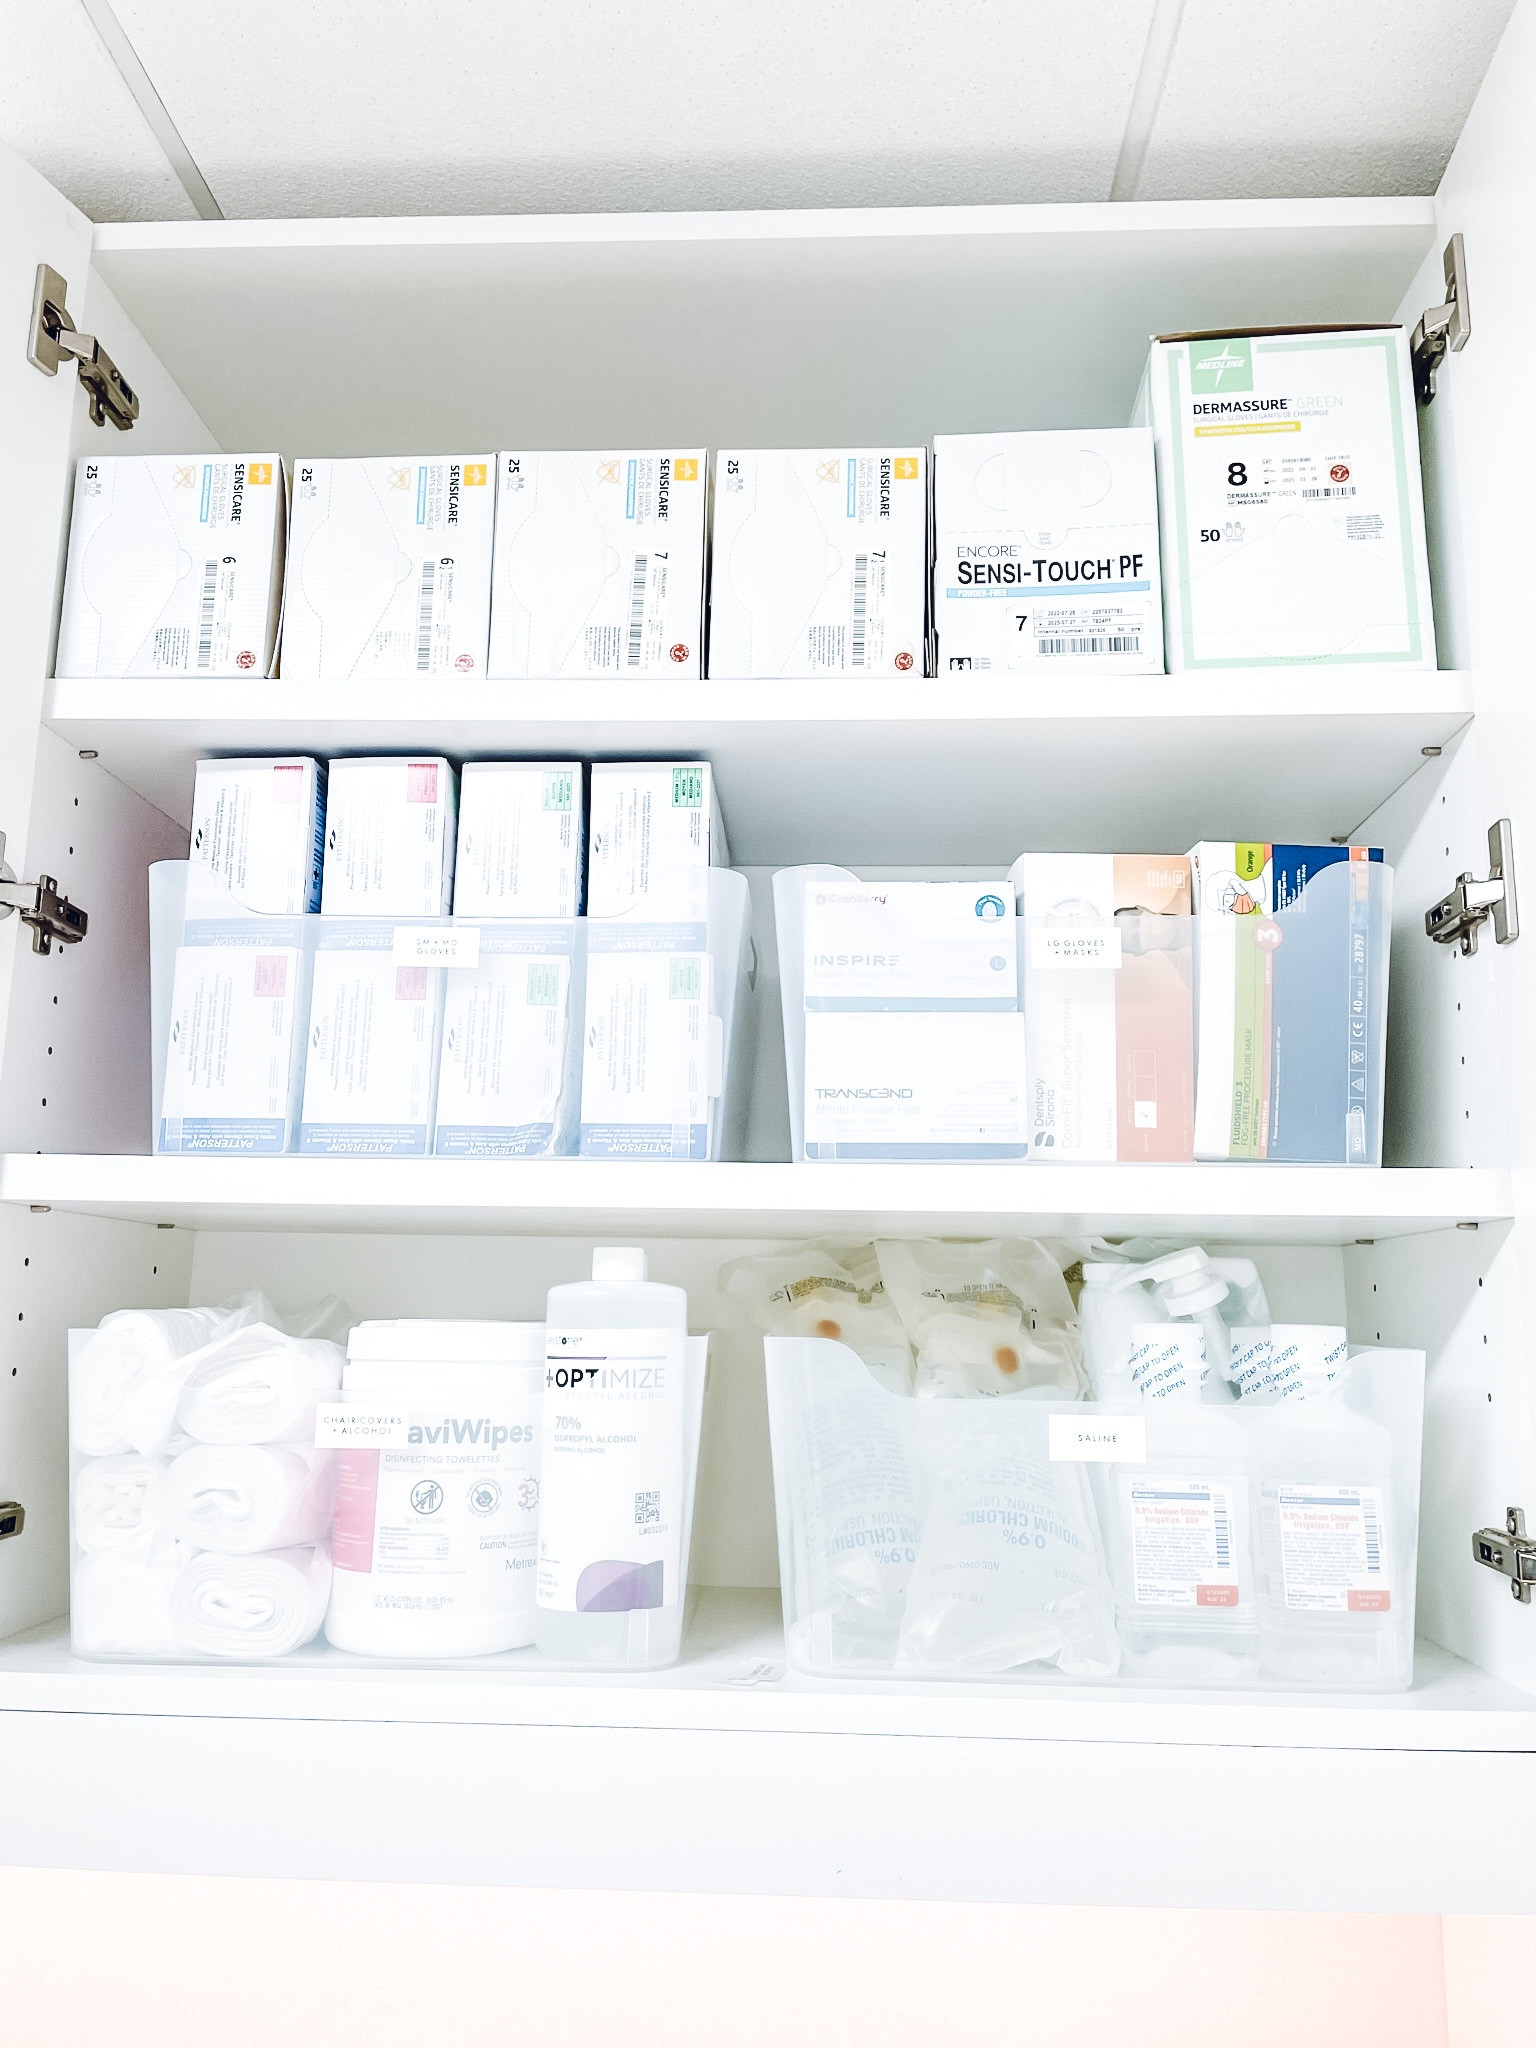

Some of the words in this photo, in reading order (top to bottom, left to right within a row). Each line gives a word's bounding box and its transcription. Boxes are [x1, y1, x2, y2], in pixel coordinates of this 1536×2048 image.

[1195, 360, 1246, 370] MEDLINE
[1193, 399, 1288, 415] DERMASSURE
[1296, 395, 1344, 409] GREEN
[1294, 409, 1329, 417] CHIRURGIE
[86, 465, 98, 479] 25
[508, 459, 520, 473] 25
[638, 459, 646, 479] GANTS
[728, 460, 739, 474] 25
[858, 458, 866, 479] GANTS
[212, 464, 220, 485] GANTS
[218, 464, 228, 494] SURGICAL
[302, 468, 312, 482] 25
[435, 465, 443, 496] SURGICAL
[645, 459, 653, 490] SURGICAL
[866, 458, 874, 489] SURGICAL
[1228, 462, 1248, 486] 8
[212, 486, 219, 494] DE
[428, 488, 435, 496] DE
[638, 482, 645, 490] DE
[858, 481, 865, 489] DE
[218, 496, 226, 520] GLOVES
[636, 492, 644, 526] CHIRURGIE
[644, 491, 652, 516] GLOVES
[210, 496, 218, 528] CHIRURGIE
[426, 497, 434, 531] CHIRURGIE
[1200, 529, 1220, 542] 50
[655, 552, 668, 560] 7
[957, 545, 1019, 558] ENCORE
[223, 556, 236, 564] 6
[958, 558, 1112, 585] SENSI-TOUCH
[1119, 554, 1143, 578] PF
[957, 589, 1007, 597] POWDER-FREE
[1015, 615, 1028, 631] 7
[1257, 928, 1277, 942] 3
[1064, 939, 1105, 947] GLOVES
[1353, 934, 1365, 963] 28797
[417, 947, 456, 955] GLOVES
[814, 955, 900, 966] INSPIRE
[1353, 1001, 1364, 1012] 40
[1061, 998, 1072, 1051] Sensitive
[1244, 1028, 1252, 1051] MASK
[1061, 1056, 1073, 1091] Super
[1243, 1053, 1251, 1103] PROCEDURE
[816, 1104, 849, 1114] Nitrile
[852, 1105, 894, 1114] Powder
[898, 1105, 921, 1114] Free
[1034, 1078, 1046, 1127] Dentsply
[1045, 1090, 1055, 1127] Sirona
[1232, 1091, 1242, 1145] FLUIDSHIELD
[1241, 1104, 1250, 1146] FOG-FREE
[331, 1143, 394, 1152] PATTERSON
[612, 1143, 672, 1152] PATTERSON
[1162, 1344, 1179, 1361] OPEN
[1282, 1345, 1298, 1361] OPEN
[1164, 1362, 1184, 1377] OPEN
[1286, 1363, 1300, 1376] OPEN
[1167, 1379, 1186, 1393] OPEN
[324, 1416, 356, 1424] CHAIR
[360, 1416, 402, 1425] COVERS
[555, 1416, 581, 1430] 70%
[342, 1427, 392, 1435] ALCOHOL
[408, 1418, 533, 1450] aviWipes
[554, 1434, 594, 1443] ISOPROPYL
[597, 1435, 637, 1443] ALCOHOL
[1078, 1434, 1117, 1443] SALINE
[386, 1456, 443, 1464] DISINFECTING
[446, 1455, 500, 1463] TOWELETTES
[954, 1509, 1028, 1527] CHLORID
[480, 1542, 506, 1550] CAUTION
[825, 1528, 896, 1557] CHLORID
[1002, 1529, 1046, 1550] 0.9%
[874, 1547, 915, 1564] 0.9%
[505, 1559, 537, 1571] Metrex
